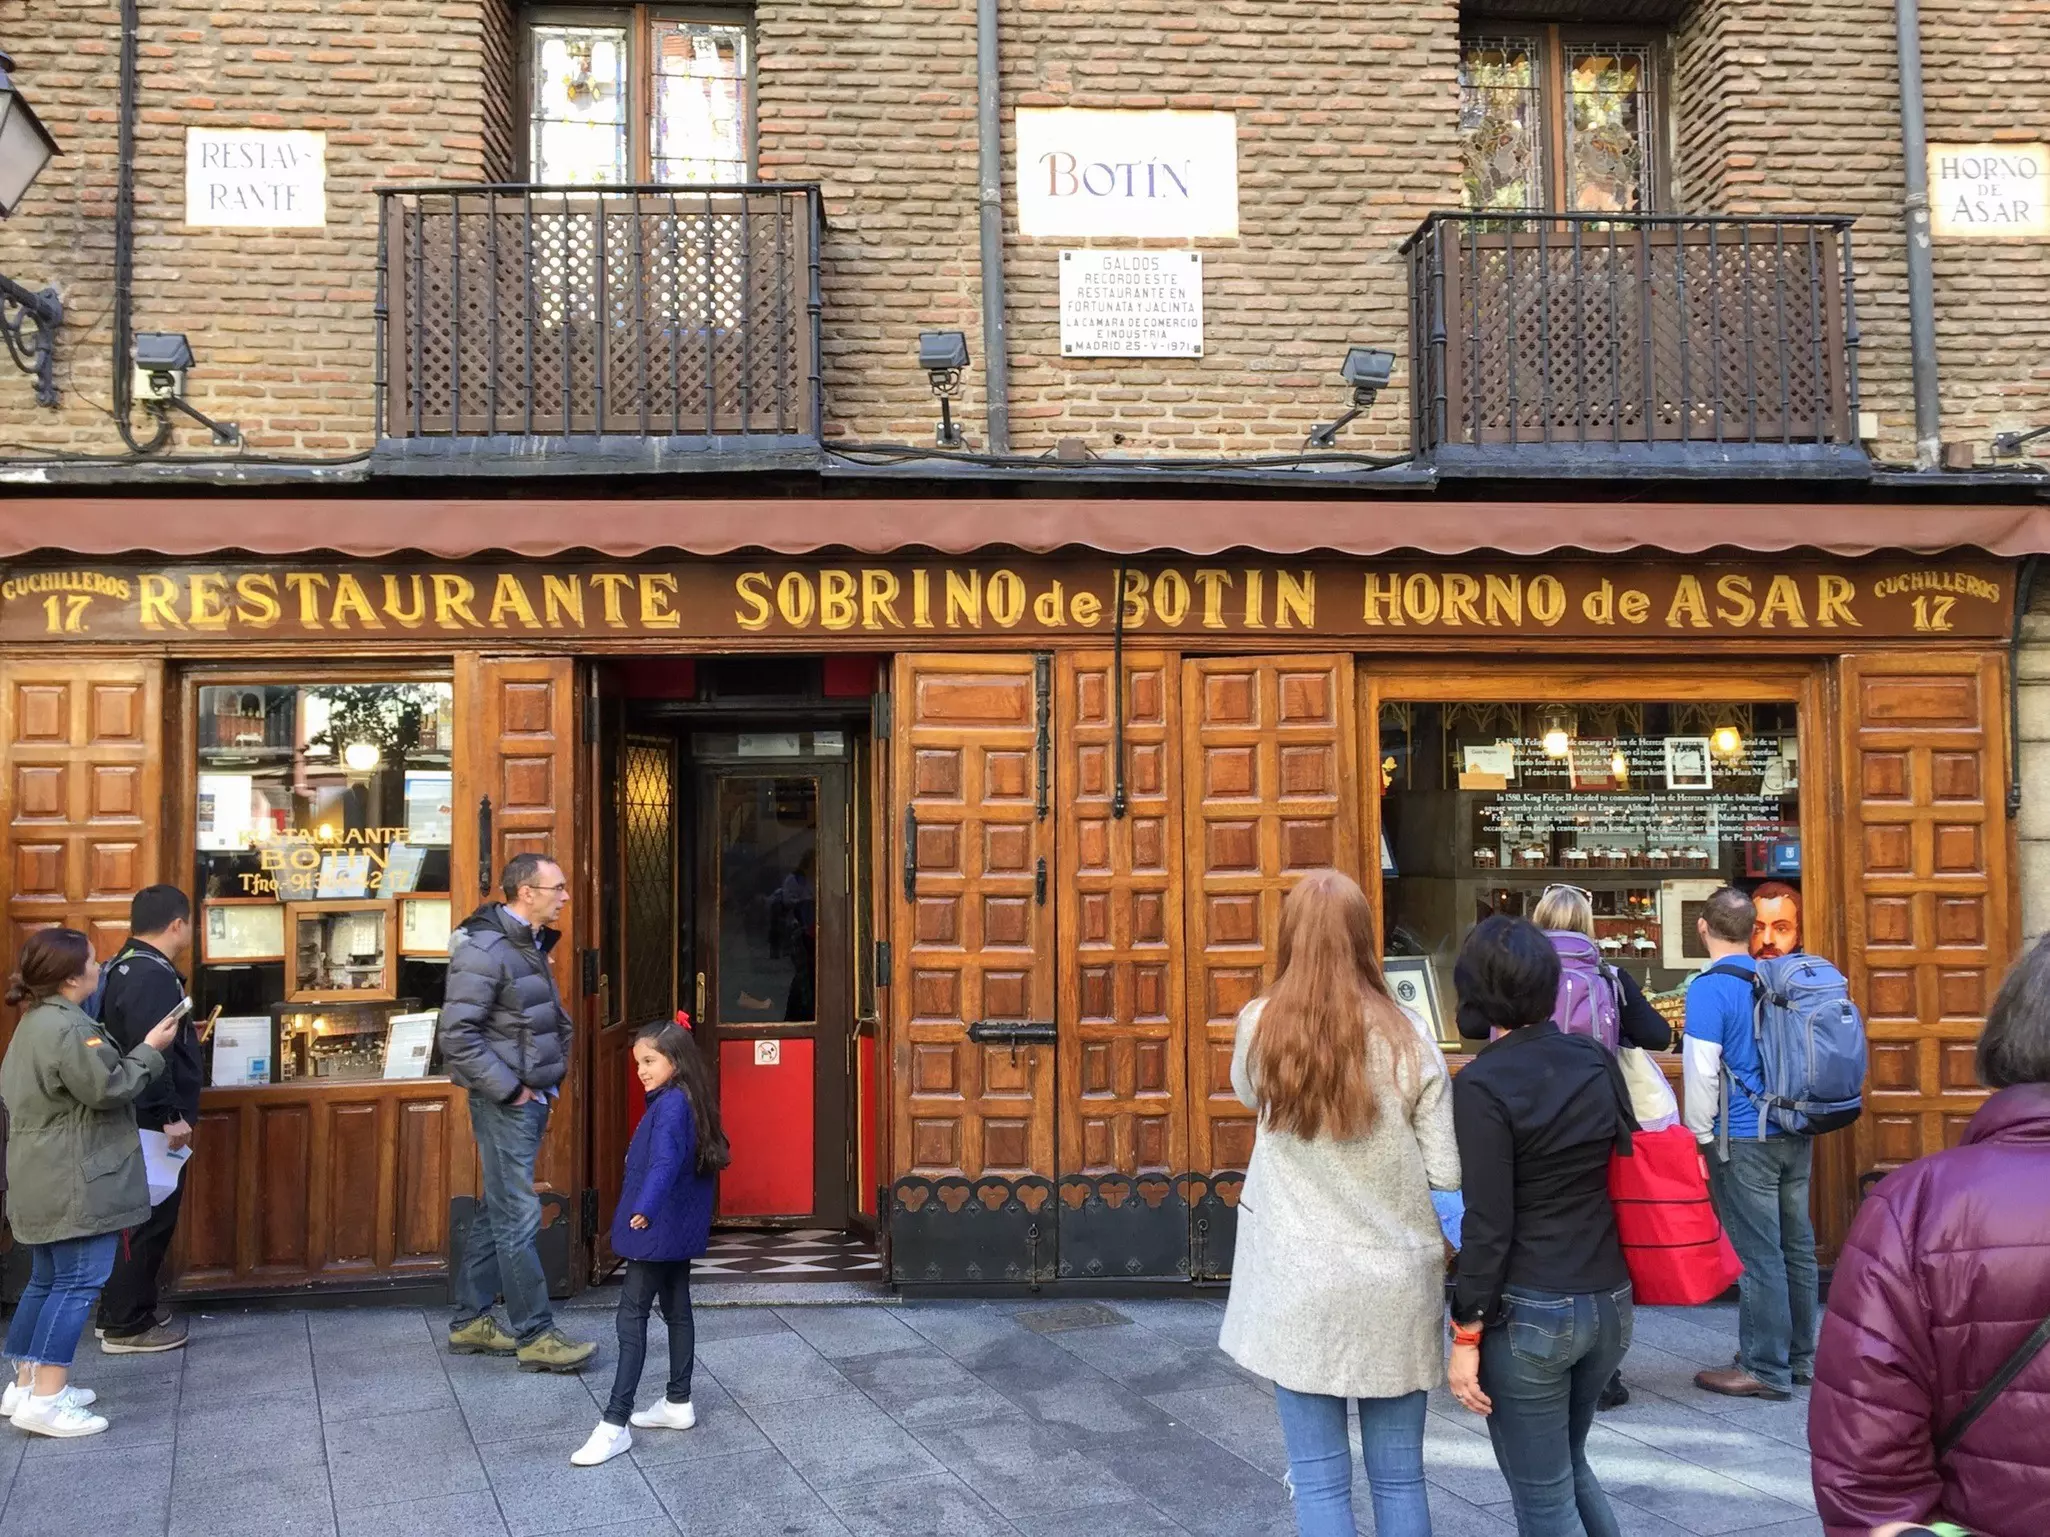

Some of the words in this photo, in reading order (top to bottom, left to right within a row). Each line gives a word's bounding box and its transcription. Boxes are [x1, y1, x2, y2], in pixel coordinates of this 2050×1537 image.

[1941, 156, 2037, 179] HORNO
[1977, 184, 2003, 196] DE
[210, 183, 302, 211] RANTE
[1952, 195, 2030, 222] ASAR
[1103, 256, 1160, 271] GALDOS
[1145, 273, 1178, 285] ESTE
[1077, 287, 1165, 298] RESTAURANTE
[1170, 287, 1186, 299] EN
[1068, 301, 1133, 313] FORTUNATA
[1137, 302, 1144, 313] Y
[1145, 302, 1195, 313] JACINTA
[1066, 318, 1079, 328] LA
[1082, 318, 1125, 328] CAMARA
[1128, 318, 1141, 328] DE
[1144, 318, 1198, 328] COMERCIO
[1097, 329, 1103, 339] E
[1106, 329, 1167, 339] INDUSTRIA
[1075, 341, 1121, 351] MADRID
[1, 571, 131, 601] CUCHILLEROS
[1874, 571, 2000, 603] CUCHILLEROS
[137, 572, 680, 631] RESTAURANTE
[735, 567, 1032, 630] SOBRINO
[1033, 579, 1102, 628] de
[1112, 567, 1316, 630] BOTIN
[1362, 573, 1567, 627] HORNO
[1583, 578, 1652, 624] de
[1665, 574, 1863, 629] ASAR
[1525, 738, 1548, 748] Felip
[1629, 738, 1637, 746] de
[1759, 738, 1768, 746] de
[1497, 793, 1504, 802] In
[1523, 793, 1541, 804] King
[1543, 793, 1564, 804] Felipe
[1573, 793, 1598, 802] decided
[1600, 794, 1608, 802] to
[1651, 793, 1666, 804] Juan
[1667, 793, 1675, 802] de
[1677, 793, 1704, 802] Herrera
[1705, 793, 1721, 802] with
[1723, 793, 1734, 802] the
[1735, 793, 1764, 804] building
[1765, 793, 1774, 802] of
[1507, 803, 1532, 814] worthy
[1533, 803, 1542, 811] of
[1543, 803, 1554, 811] the
[1555, 803, 1577, 813] capital
[1580, 803, 1588, 811] of
[1627, 803, 1660, 814] Although
[1739, 803, 1751, 811] the
[1751, 803, 1769, 813] reign
[1770, 803, 1779, 811] of
[1527, 813, 1541, 821] that
[1542, 813, 1553, 821] the
[1554, 814, 1575, 823] square
[1681, 813, 1693, 821] the
[1609, 824, 1635, 834] homage
[1646, 824, 1657, 832] the
[261, 847, 390, 870] BOTIN
